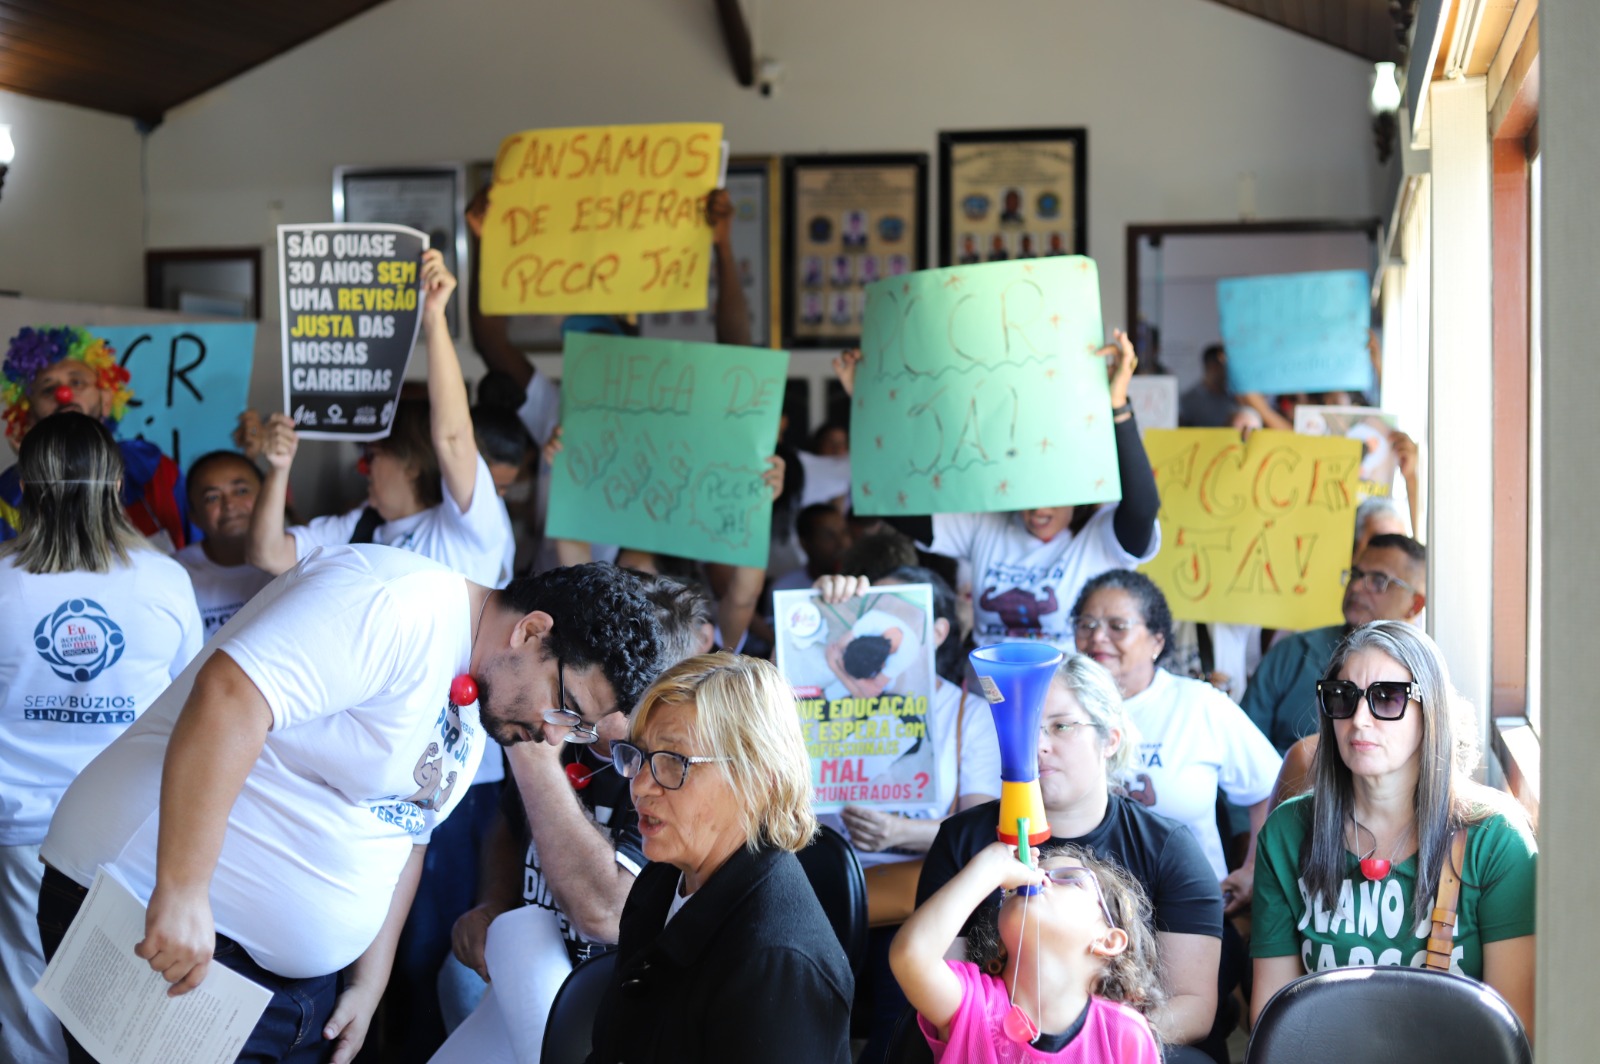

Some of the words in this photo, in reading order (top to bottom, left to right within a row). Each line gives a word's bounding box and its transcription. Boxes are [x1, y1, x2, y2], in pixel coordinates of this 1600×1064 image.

[494, 132, 710, 185] CANSAMOS
[501, 204, 550, 246] DE
[287, 231, 329, 258] SÃO
[332, 234, 396, 259] QUASE
[288, 260, 316, 284] 30
[319, 260, 374, 284] ANOS
[377, 261, 417, 284] SEM
[502, 253, 620, 303] PCCR
[289, 287, 334, 311] UMA
[337, 284, 417, 311] REVISÃO
[291, 314, 355, 338] JUSTA
[358, 315, 395, 338] DAS
[291, 341, 369, 365] NOSSAS
[292, 368, 393, 392] CARREIRAS
[568, 345, 695, 412] CHEGA
[722, 365, 780, 413] DE
[1172, 519, 1319, 603] JÁ!
[61, 633, 97, 643] acredito
[67, 624, 86, 636] Eu
[73, 640, 97, 649] meu
[24, 693, 136, 709] SERVBÚZIOS
[796, 699, 825, 720] UE
[829, 691, 928, 721] EDUCAÇÃO
[26, 710, 134, 723] SINDICATO
[818, 720, 891, 742] ESPERA
[806, 740, 900, 758] OFISSIONAIS
[819, 758, 869, 784] MAL
